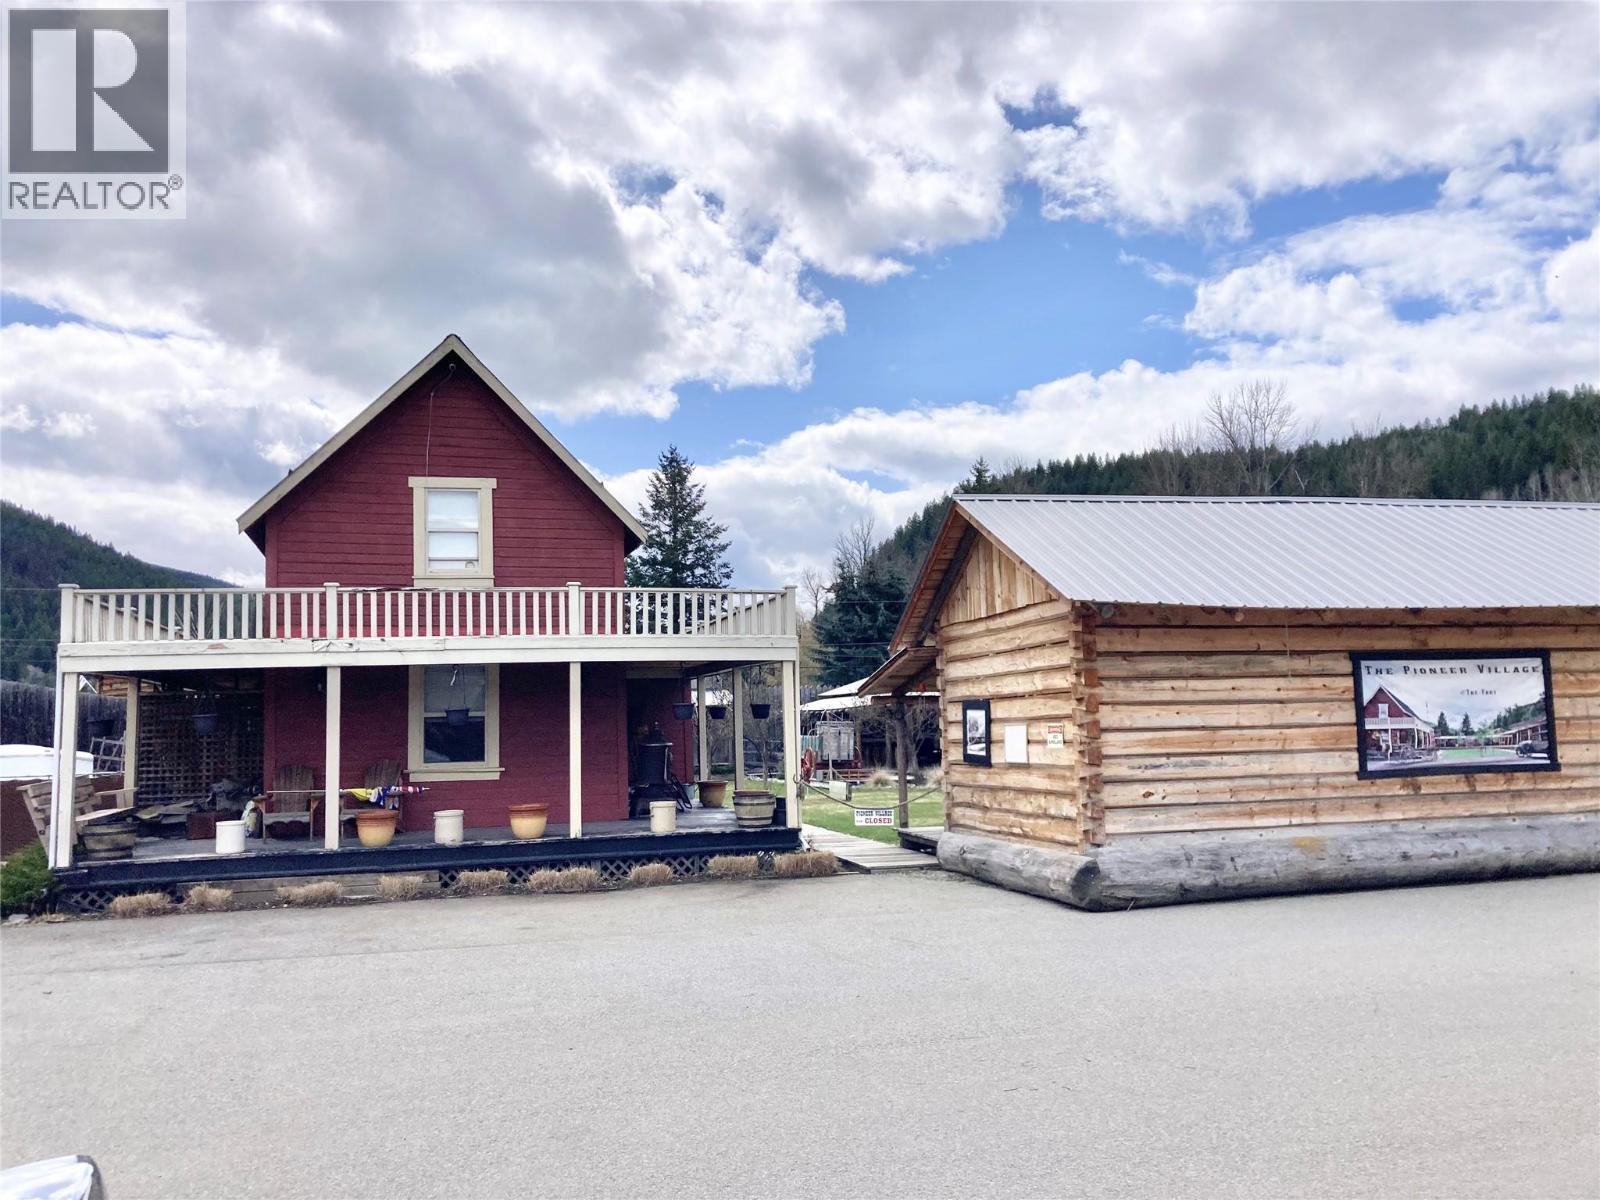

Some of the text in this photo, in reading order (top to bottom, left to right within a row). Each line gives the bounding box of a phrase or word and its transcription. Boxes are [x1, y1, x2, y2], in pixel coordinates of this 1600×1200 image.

[1364, 664, 1541, 676] THE PIONEER VILLAGE
